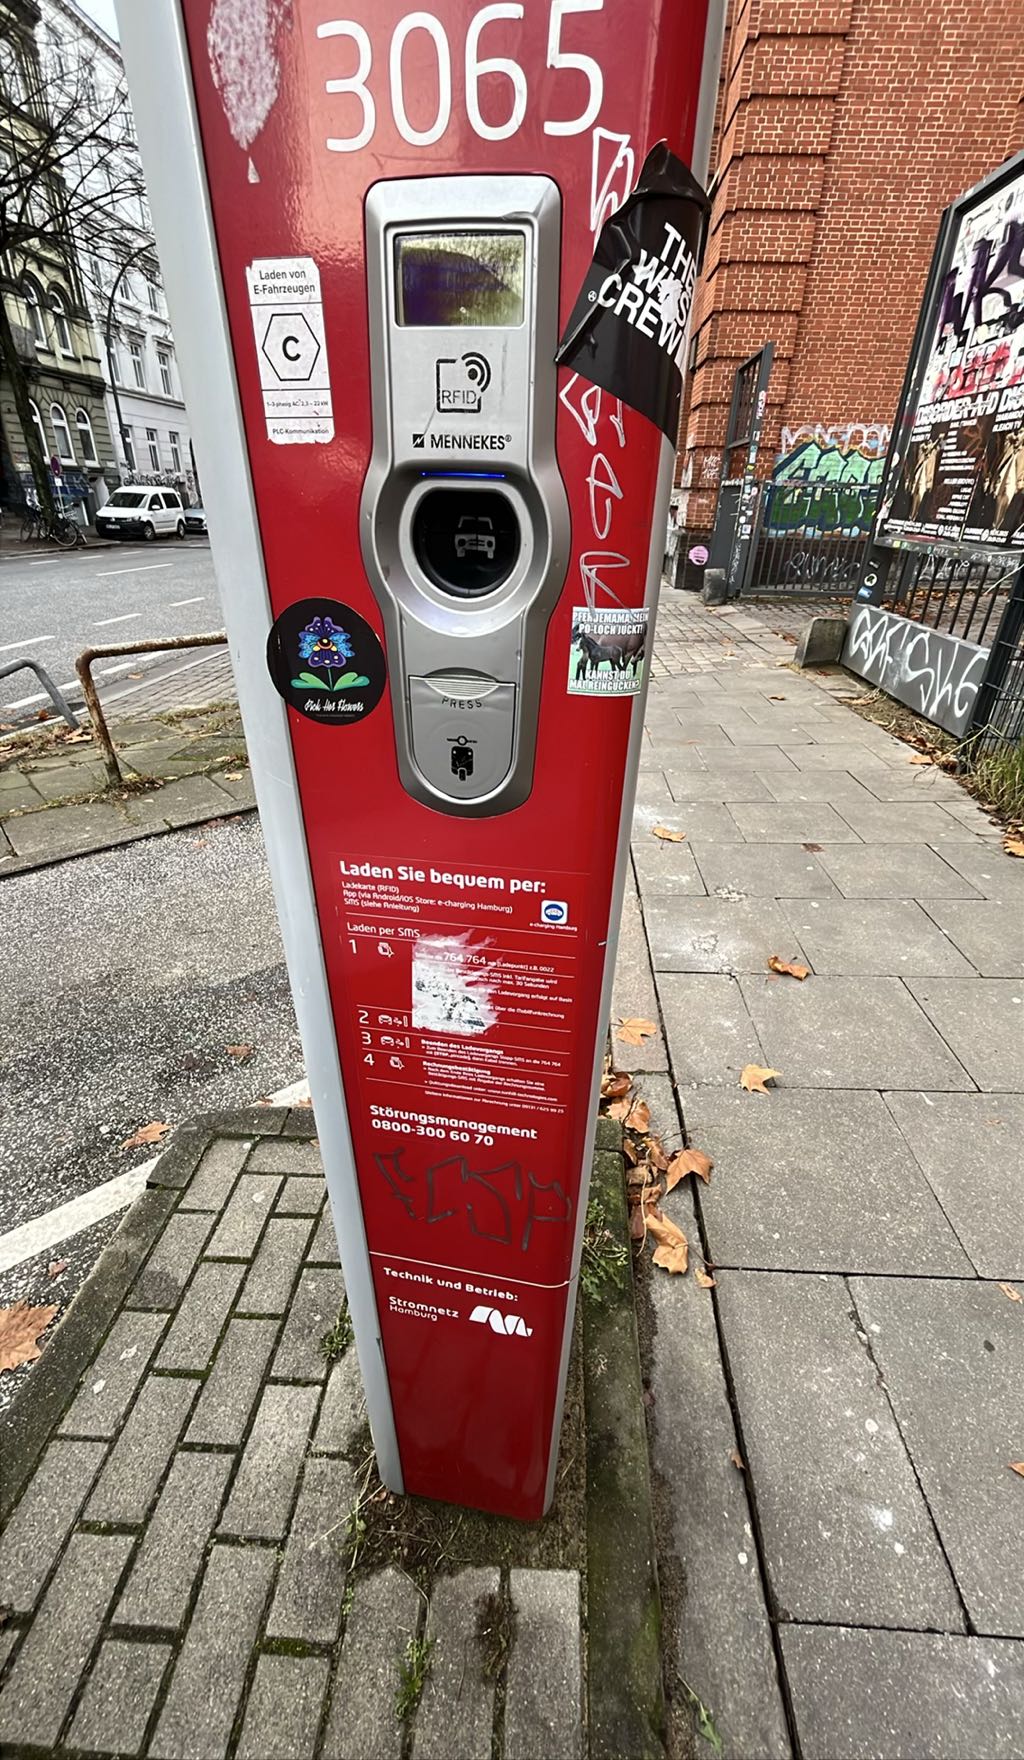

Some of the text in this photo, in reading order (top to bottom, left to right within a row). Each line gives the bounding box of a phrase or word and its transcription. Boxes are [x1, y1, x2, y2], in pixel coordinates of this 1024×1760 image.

[316, 0, 604, 153] 3065
[259, 270, 306, 280] Laden von
[254, 284, 315, 295] E-Fahrzeugen
[598, 273, 683, 356] CREW
[282, 336, 301, 362] C
[442, 390, 476, 404] RFID
[579, 624, 616, 634] PO-LOCH
[585, 670, 619, 680] KANNST
[442, 696, 482, 709] PRESS
[340, 860, 546, 894] Laden Sie bequem per:
[342, 881, 399, 894] Ladekarte (RFID)
[343, 890, 513, 914] App (via Android/iOS Store: e-charging Hamburg)
[344, 898, 420, 913] SMS (siehe Anleitung)
[347, 922, 420, 938] Laden per SMS
[349, 939, 357, 954] 1
[443, 952, 464, 963] 764
[466, 954, 486, 965] 764
[358, 1010, 369, 1024] 2
[361, 1032, 371, 1045] 3
[364, 1054, 375, 1066] 4
[370, 1105, 537, 1139] Störungsmanagement
[372, 1119, 494, 1146] 0800-300 60 70
[383, 1267, 518, 1302] Technik und Betrieb:
[389, 1296, 459, 1317] Stromnetz
[389, 1305, 438, 1321] Hamburg
